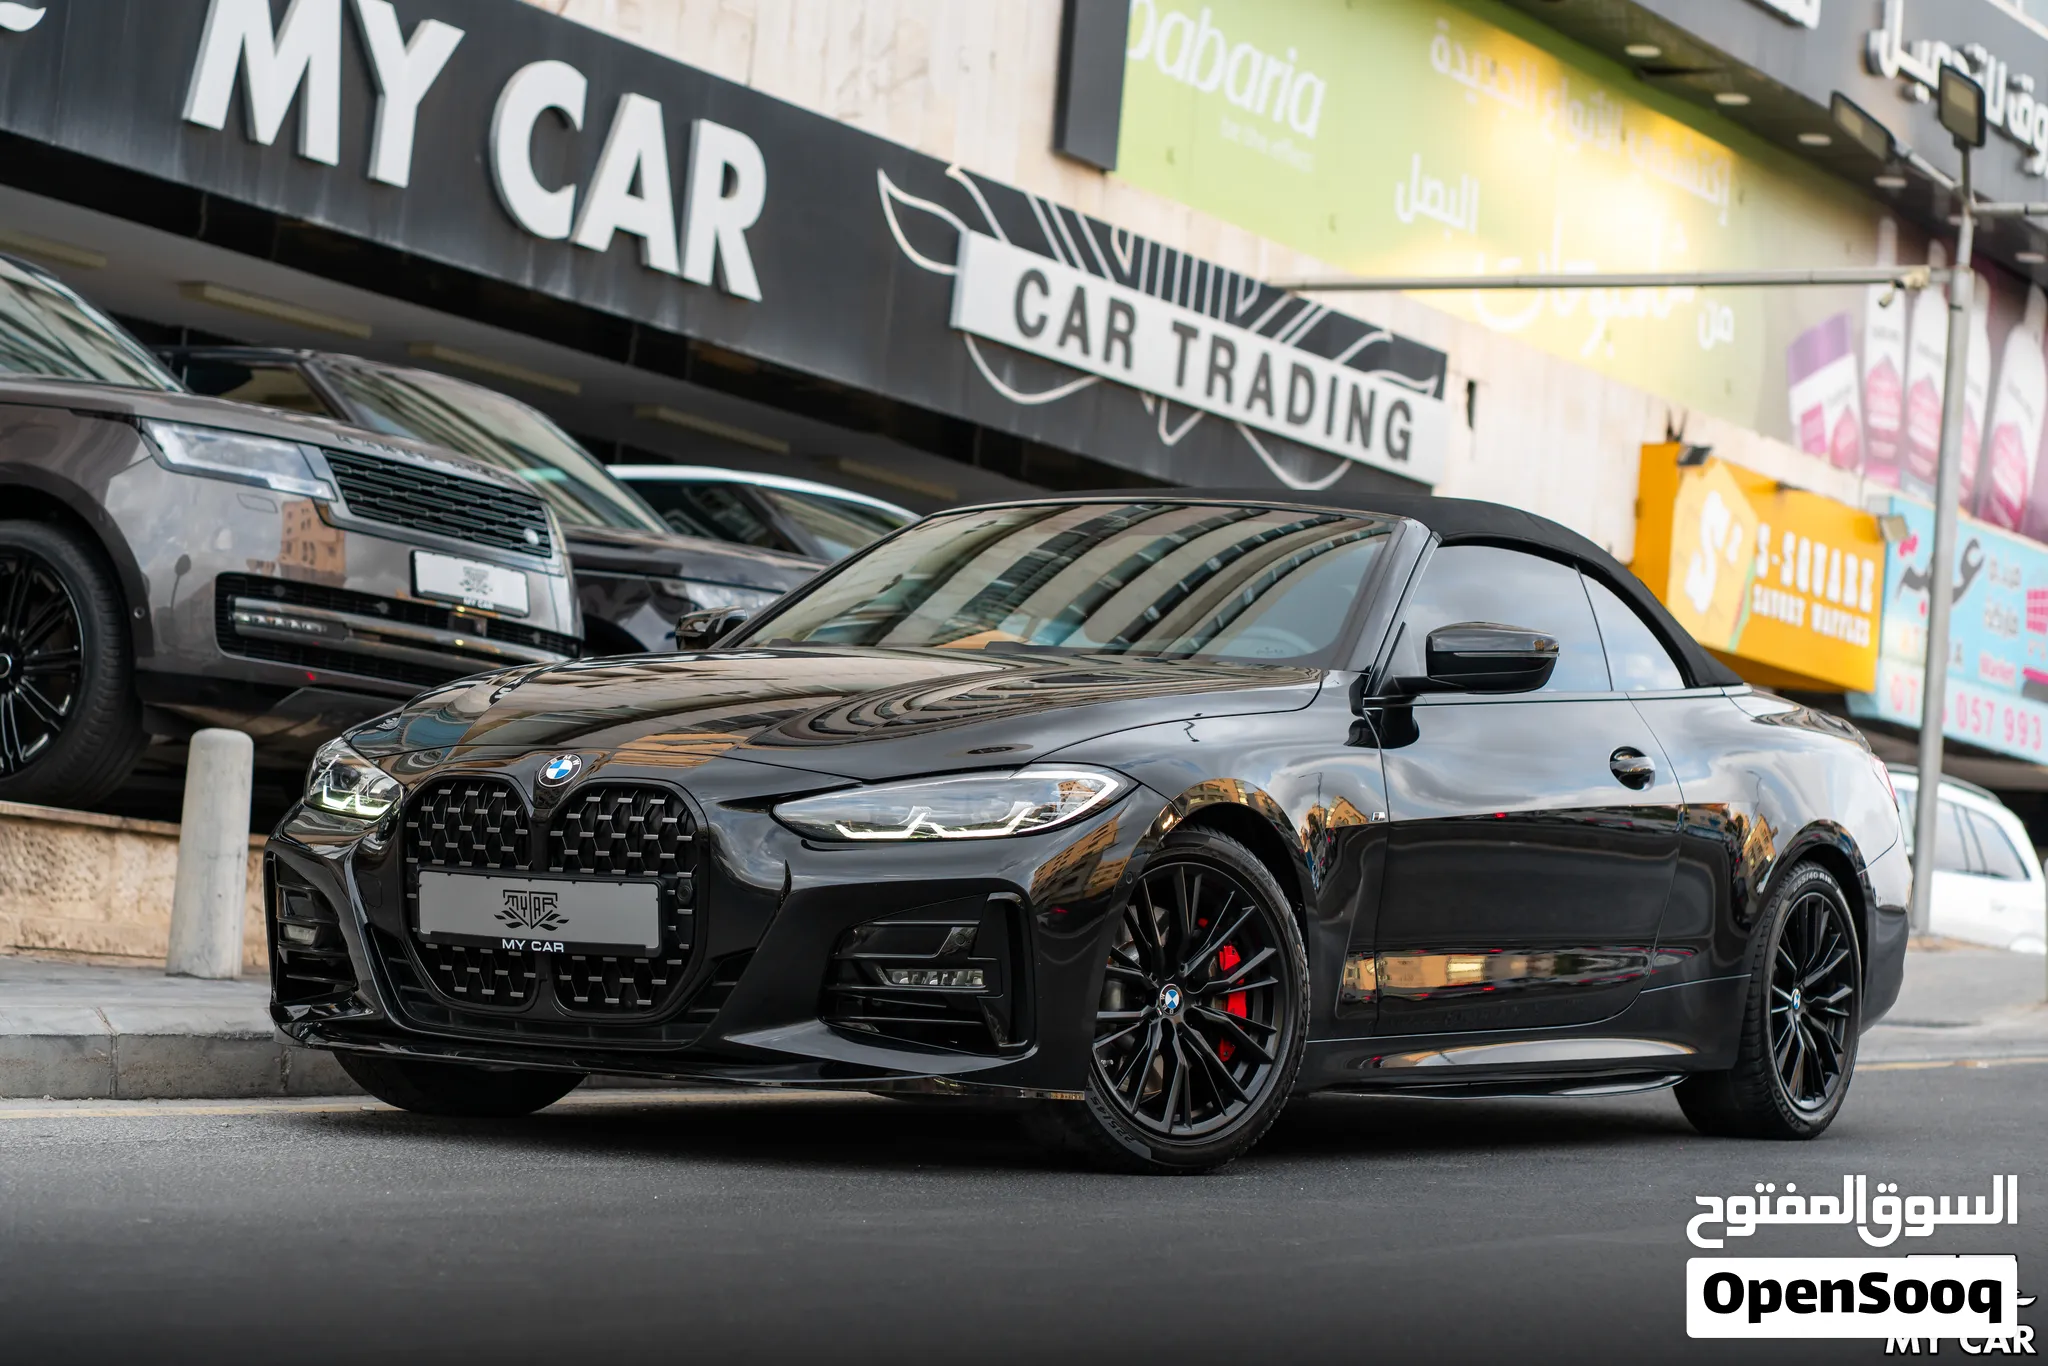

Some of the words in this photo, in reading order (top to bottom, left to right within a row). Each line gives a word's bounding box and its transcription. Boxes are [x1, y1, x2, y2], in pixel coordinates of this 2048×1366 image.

[181, 0, 465, 188] MY
[489, 59, 767, 301] CAR
[1014, 267, 1137, 373] CAR
[1171, 320, 1414, 464] TRADING
[502, 939, 526, 950] MY
[531, 941, 564, 953] CAR
